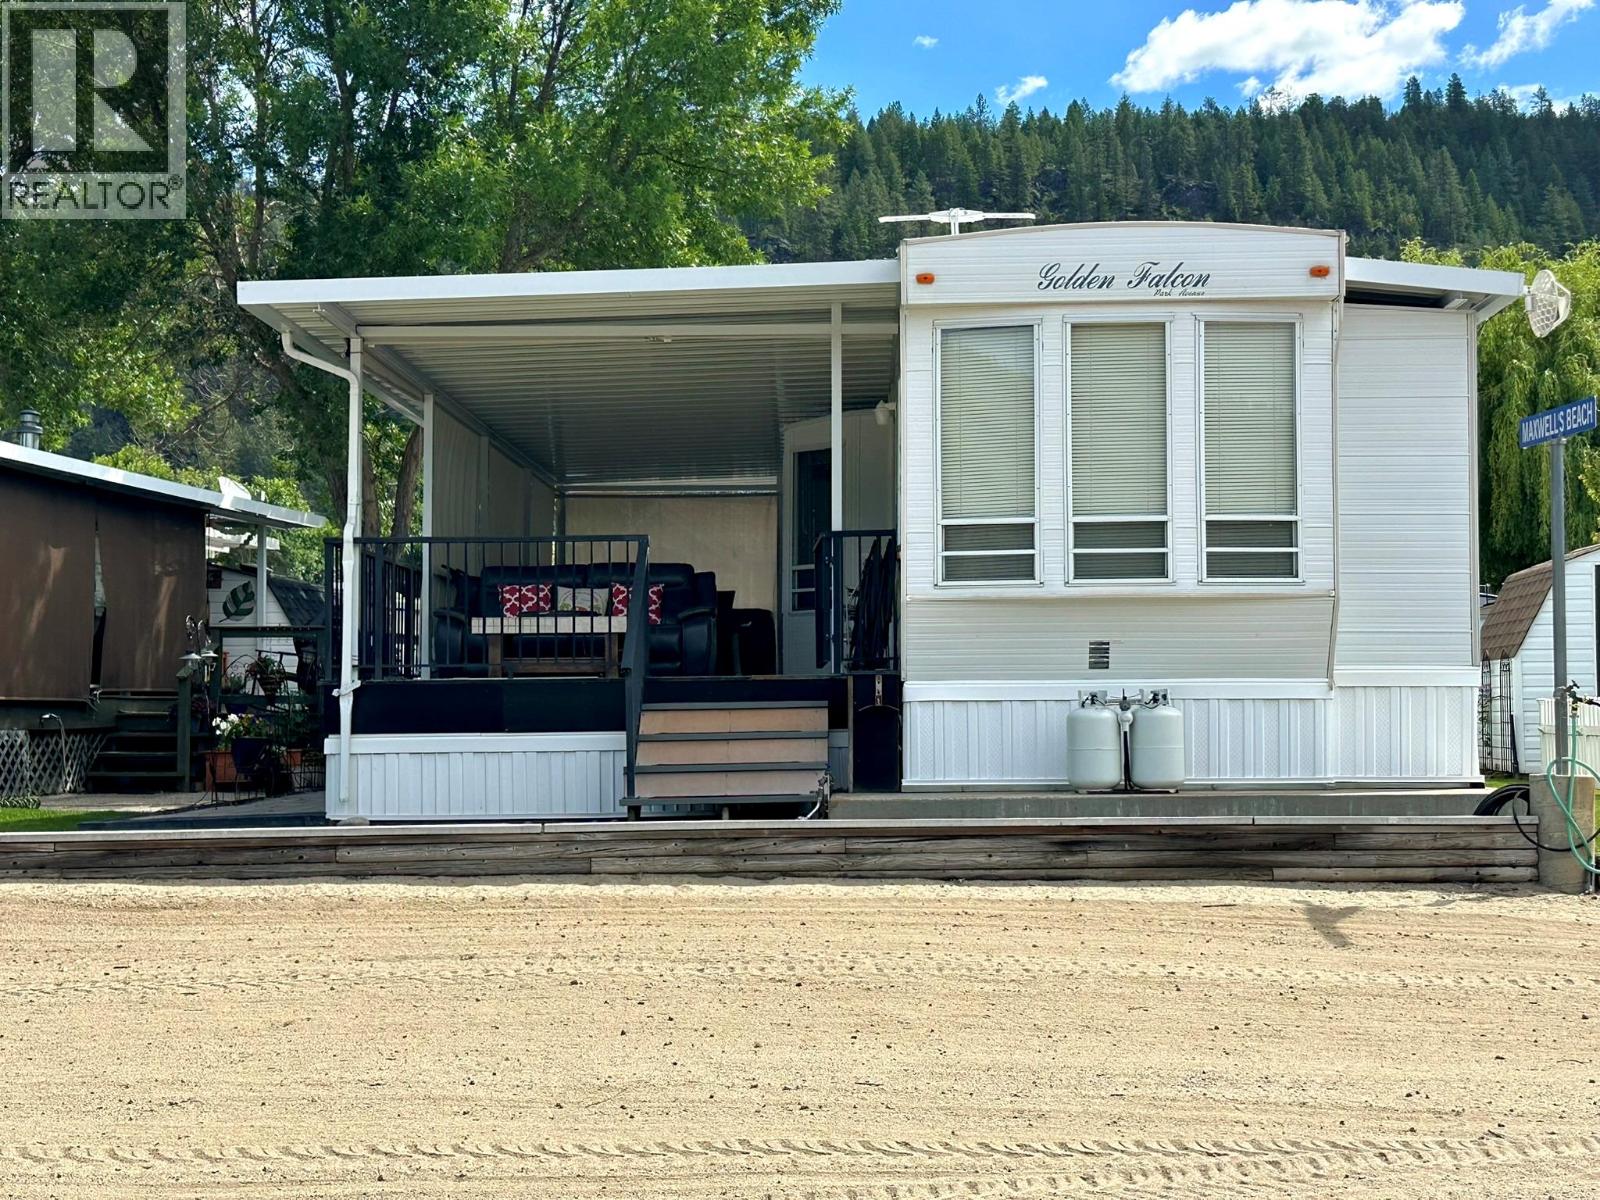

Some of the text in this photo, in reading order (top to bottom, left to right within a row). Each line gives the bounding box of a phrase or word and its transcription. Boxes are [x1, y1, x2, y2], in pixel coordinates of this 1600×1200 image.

[1037, 261, 1211, 291] Golden Falcon
[1566, 401, 1594, 430] BEACH
